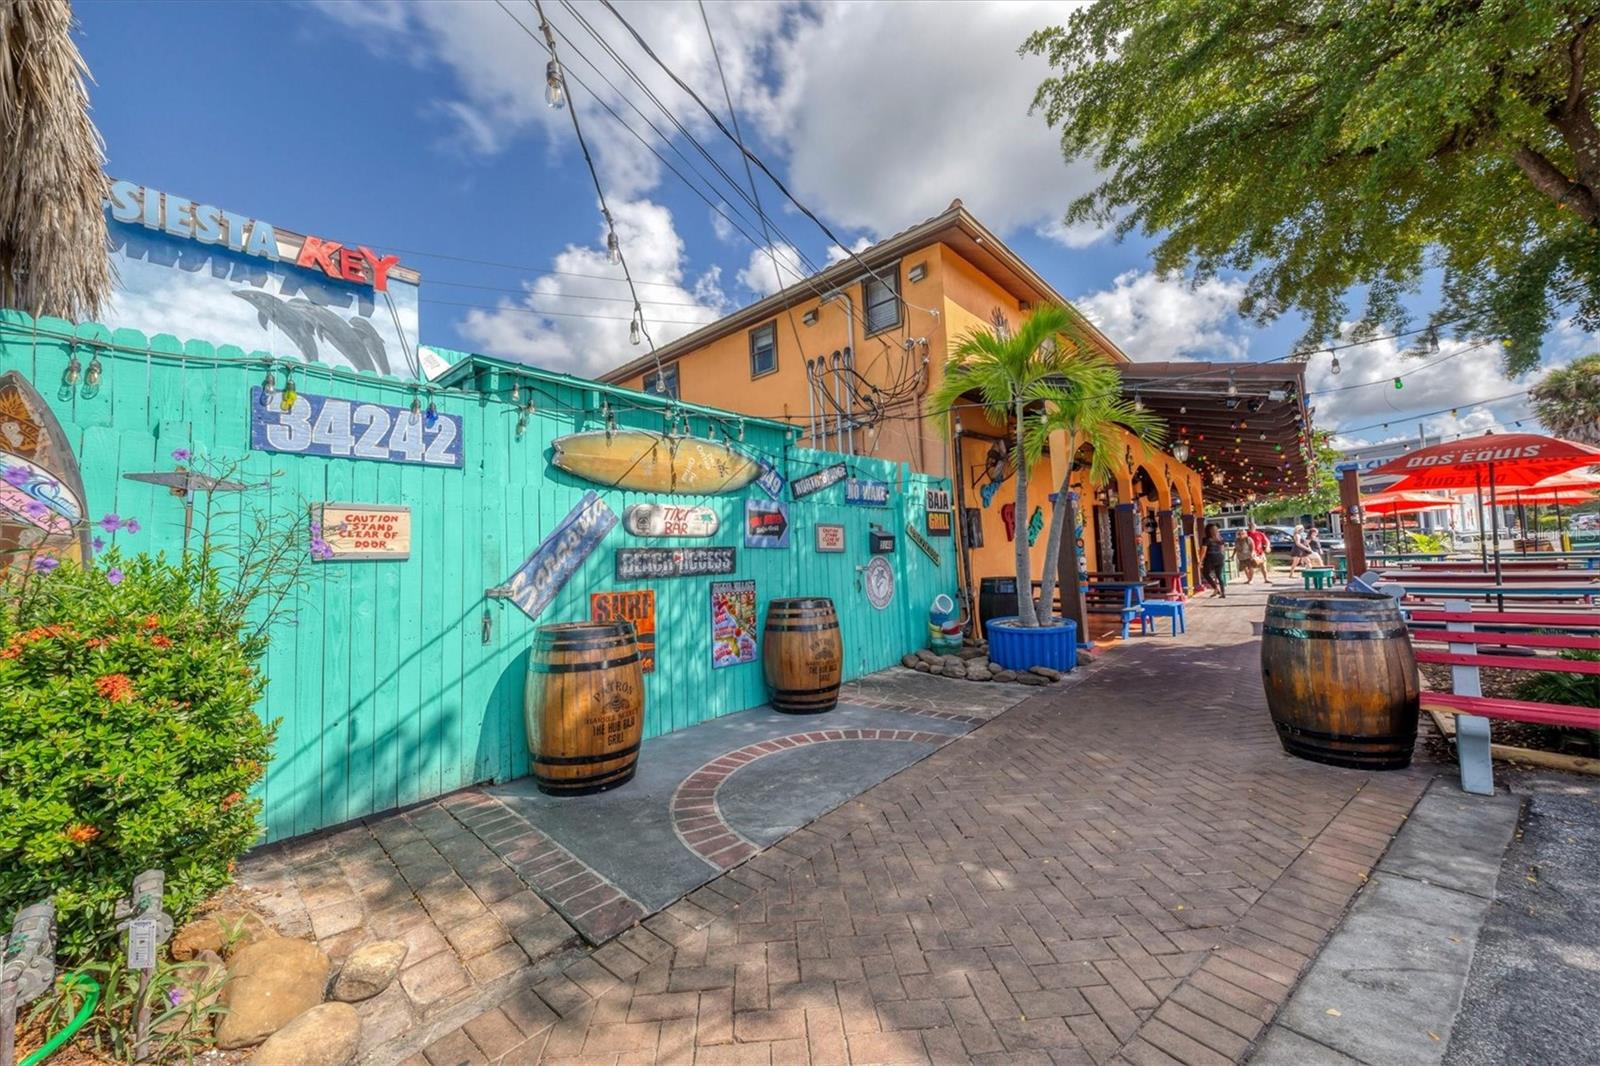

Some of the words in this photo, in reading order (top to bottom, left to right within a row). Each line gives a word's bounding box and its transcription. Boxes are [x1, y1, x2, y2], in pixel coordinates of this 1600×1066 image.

[110, 180, 280, 262] SIESTA
[296, 235, 401, 292] KEY
[265, 394, 457, 465] 34242
[1405, 453, 1454, 468] DOS
[1460, 444, 1541, 463] EQUIS
[927, 491, 949, 510] BAJA
[344, 514, 399, 523] CAUTION
[663, 507, 690, 521] TIKI
[351, 522, 393, 531] STAND
[664, 521, 689, 535] BAR
[928, 513, 950, 530] GRILL
[339, 530, 379, 539] CLEAR
[383, 531, 399, 540] OF
[354, 540, 386, 549] DOOR
[621, 552, 675, 575] BEACH
[680, 548, 732, 571] ACCESS
[592, 724, 605, 737] THE
